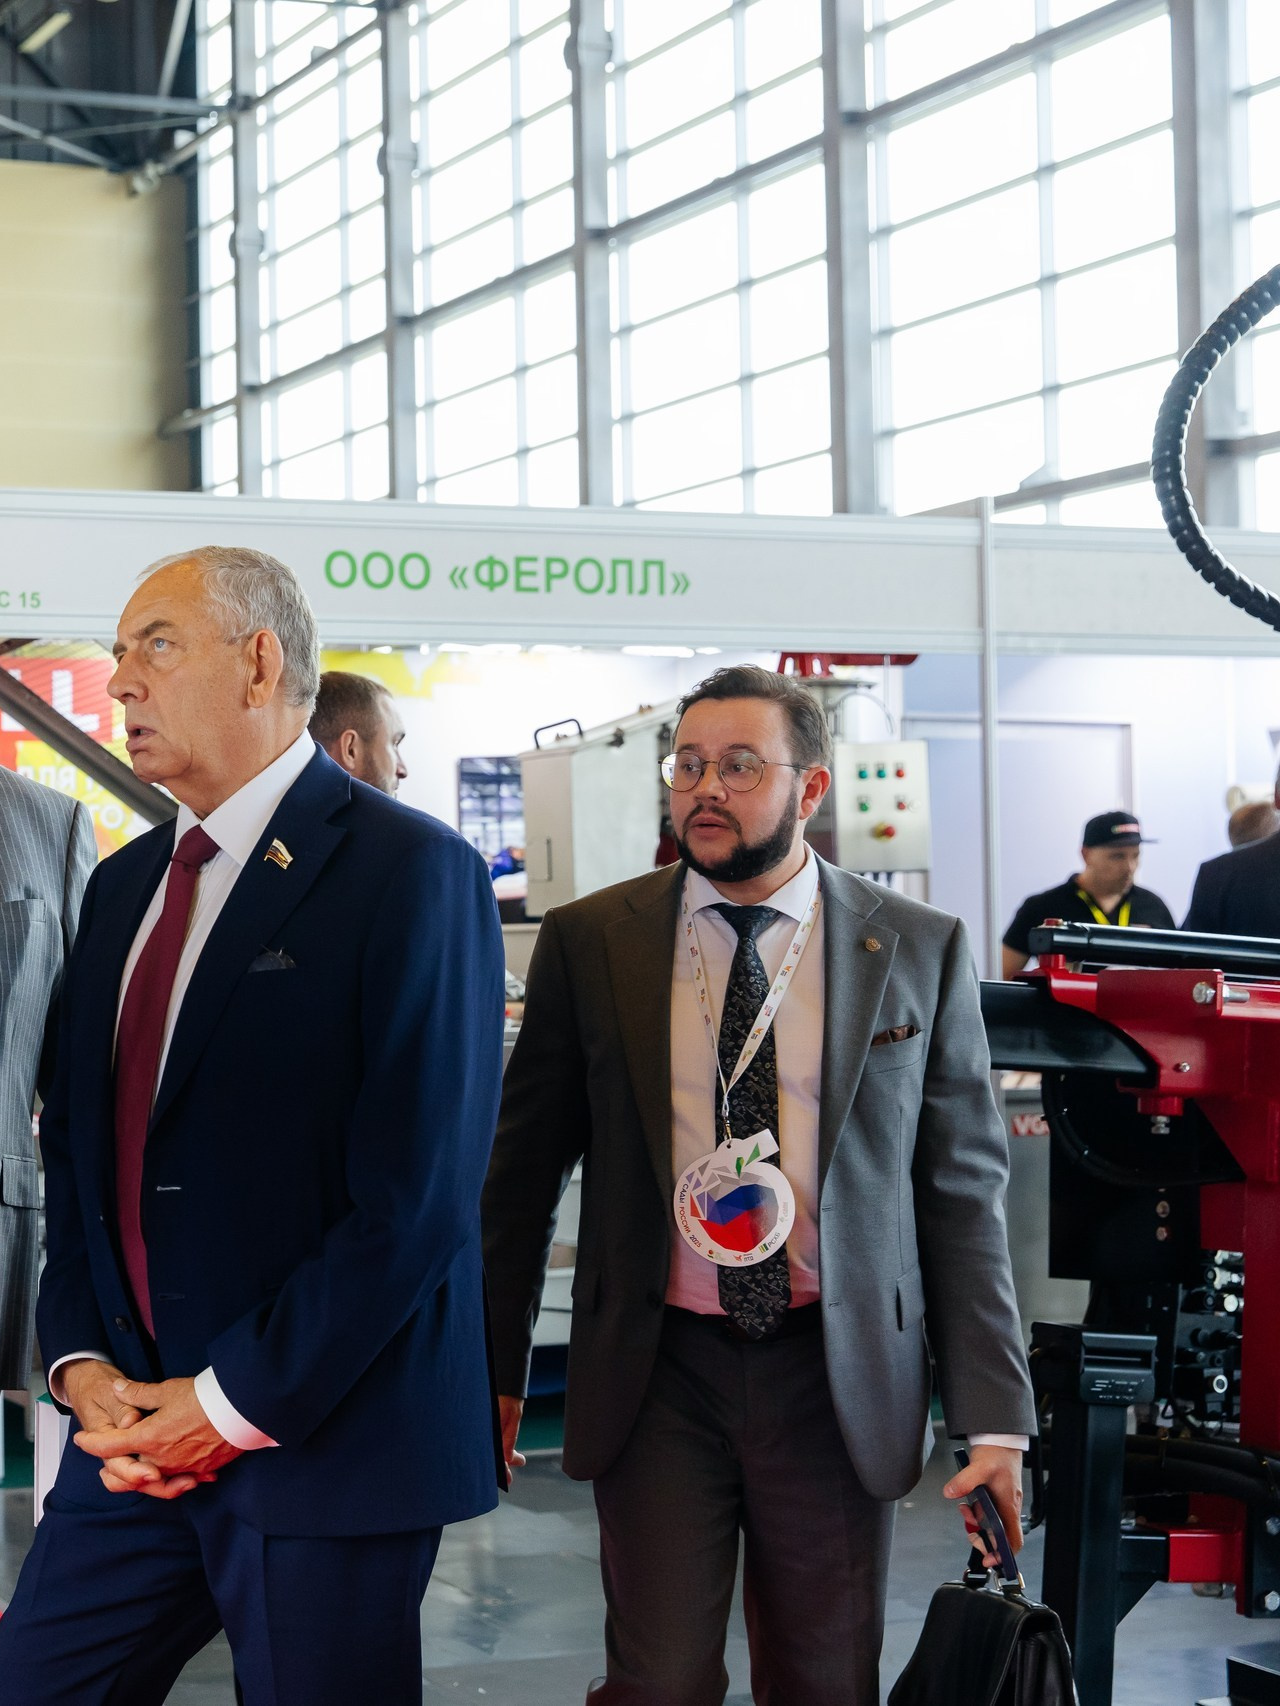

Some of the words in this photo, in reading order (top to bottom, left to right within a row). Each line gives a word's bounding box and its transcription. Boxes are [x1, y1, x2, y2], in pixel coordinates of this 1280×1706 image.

[324, 550, 431, 590] ООО
[448, 554, 691, 597] «ФЕРОЛЛ»
[19, 591, 41, 609] 15
[679, 1183, 689, 1204] САДЫ
[679, 1205, 692, 1234] РОССИИ
